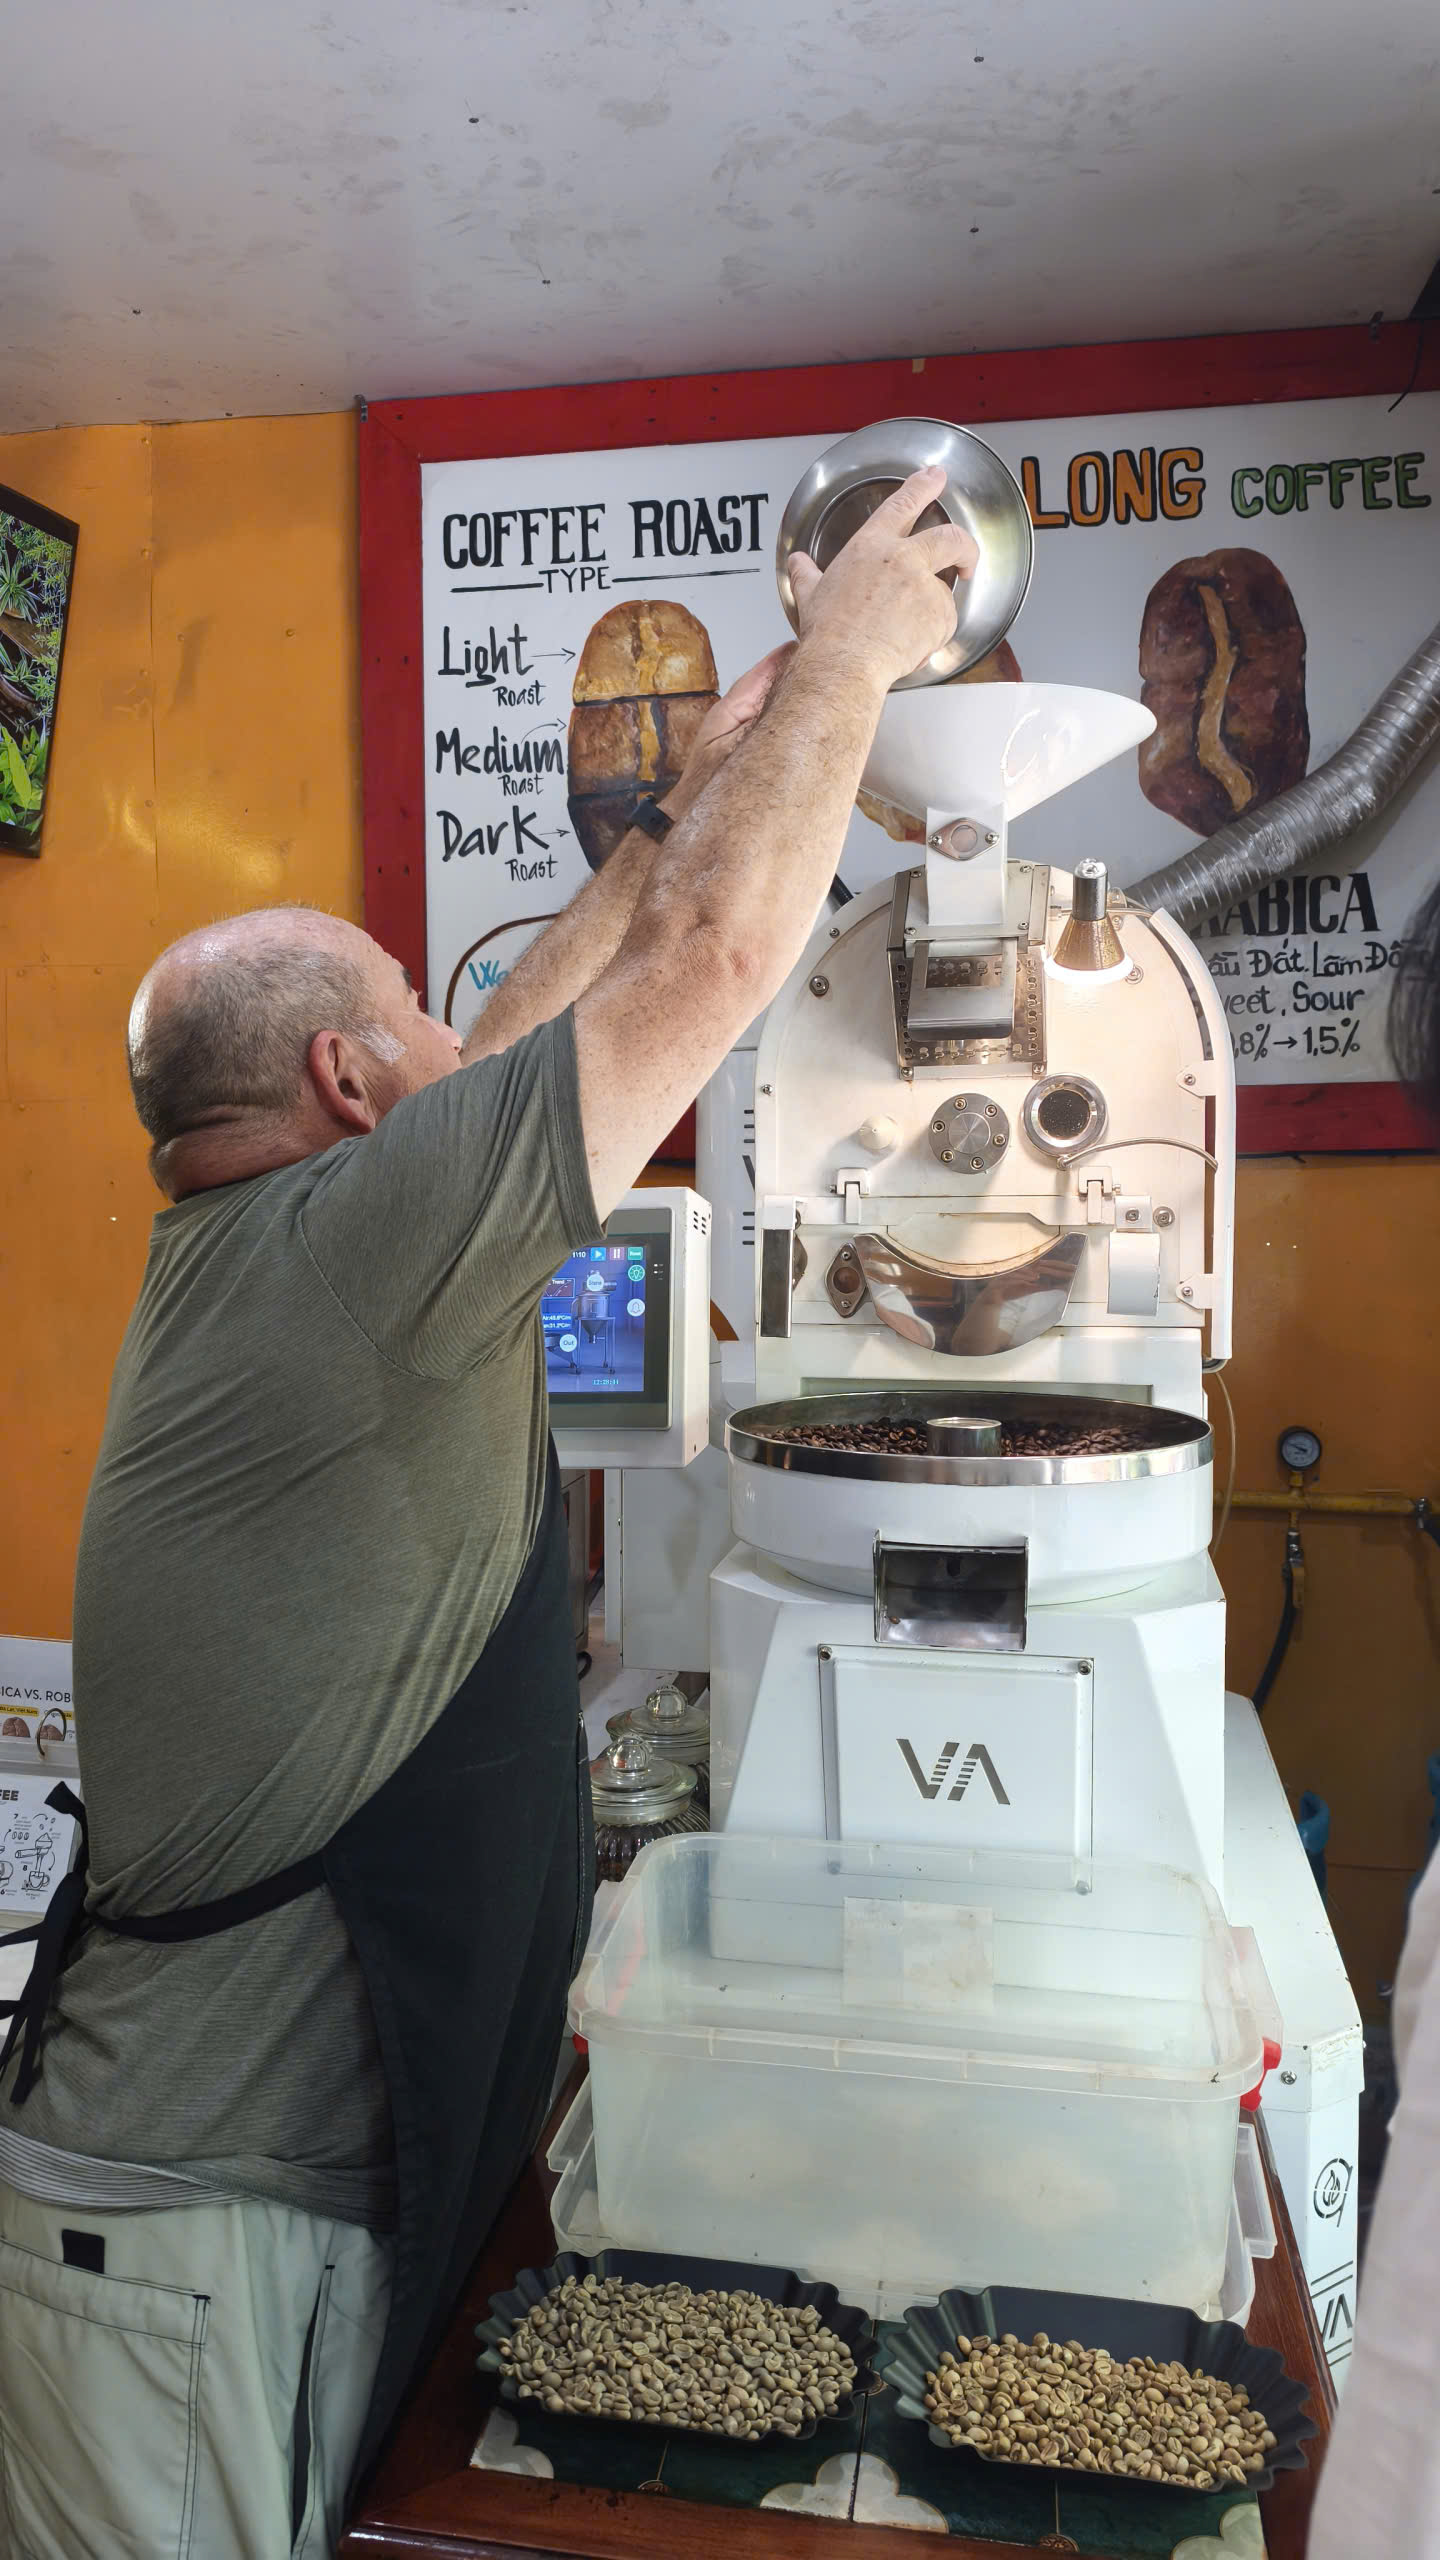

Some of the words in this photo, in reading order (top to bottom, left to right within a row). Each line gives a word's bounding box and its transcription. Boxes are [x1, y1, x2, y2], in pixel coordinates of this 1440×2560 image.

[1021, 447, 1206, 529] LONG
[1231, 452, 1431, 519] COFFEE
[443, 503, 606, 569] COFFEE
[628, 493, 768, 559] ROAST
[539, 566, 612, 593] TYPE
[438, 623, 533, 687] Light
[493, 680, 546, 708] Roast
[435, 726, 565, 775] Medium
[498, 773, 544, 798] Roast
[505, 854, 558, 882] Roast
[1190, 872, 1381, 937] ABICA
[1292, 981, 1365, 1013] Sour
[0, 1686, 22, 1698] ICA
[24, 1688, 42, 1700] VS.
[46, 1690, 71, 1703] ROB
